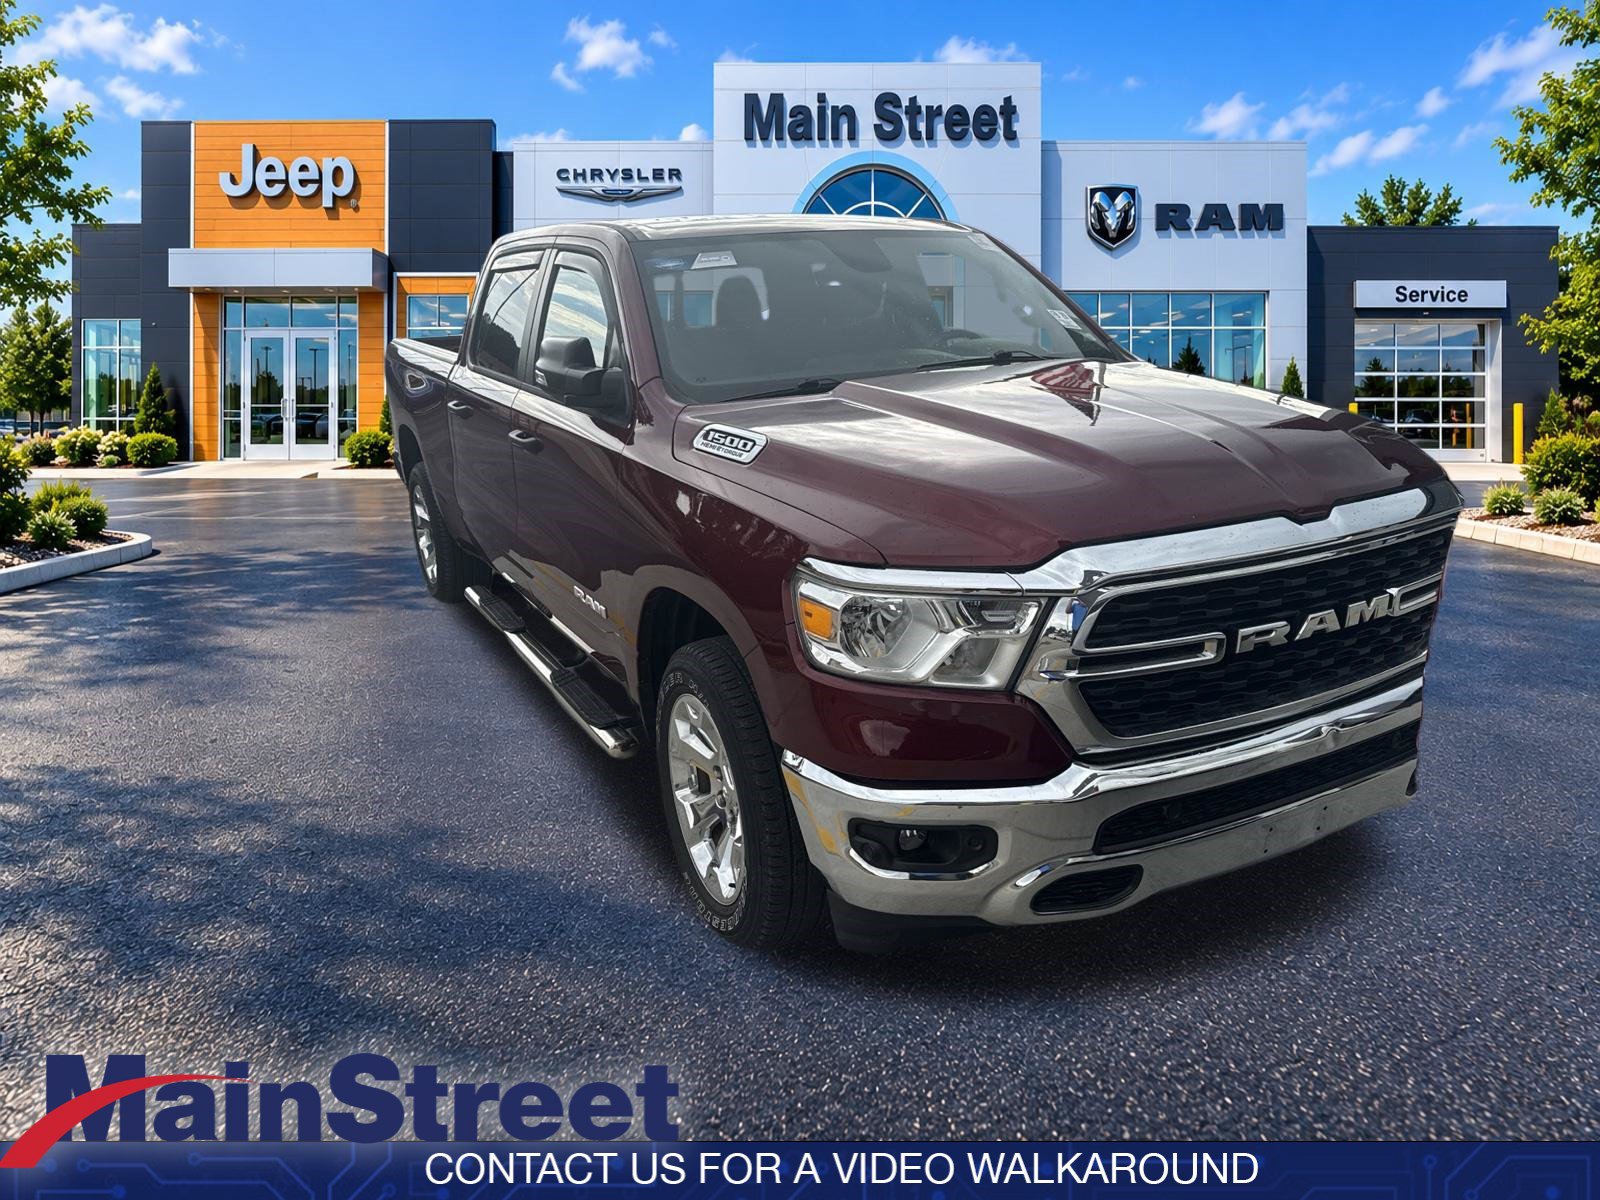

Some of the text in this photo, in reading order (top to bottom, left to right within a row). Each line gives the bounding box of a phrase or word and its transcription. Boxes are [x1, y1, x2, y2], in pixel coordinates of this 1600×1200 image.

[743, 92, 1018, 142] Main Street
[218, 143, 356, 209] Jeep
[556, 168, 683, 182] CHRYSLER
[1155, 203, 1284, 232] RAM
[1395, 285, 1469, 304] Service
[707, 431, 754, 451] 1500
[574, 585, 607, 620] RAM
[1235, 593, 1391, 654] RAM
